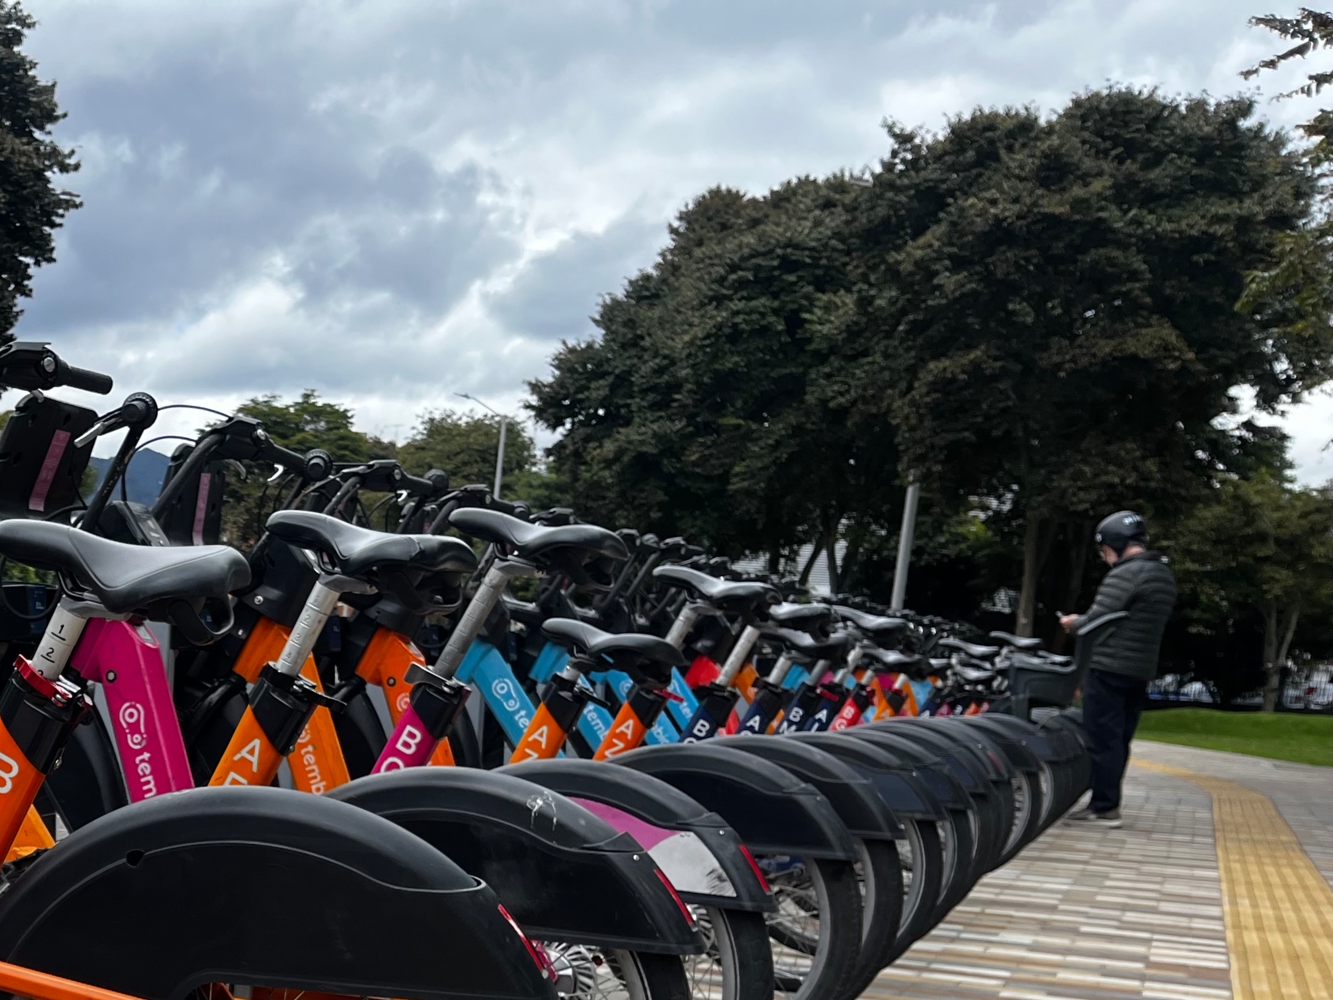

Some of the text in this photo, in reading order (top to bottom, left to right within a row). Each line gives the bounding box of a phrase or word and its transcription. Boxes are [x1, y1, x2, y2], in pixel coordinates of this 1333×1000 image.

[59, 624, 65, 634] 1
[45, 647, 55, 659] 2
[514, 710, 530, 732] te
